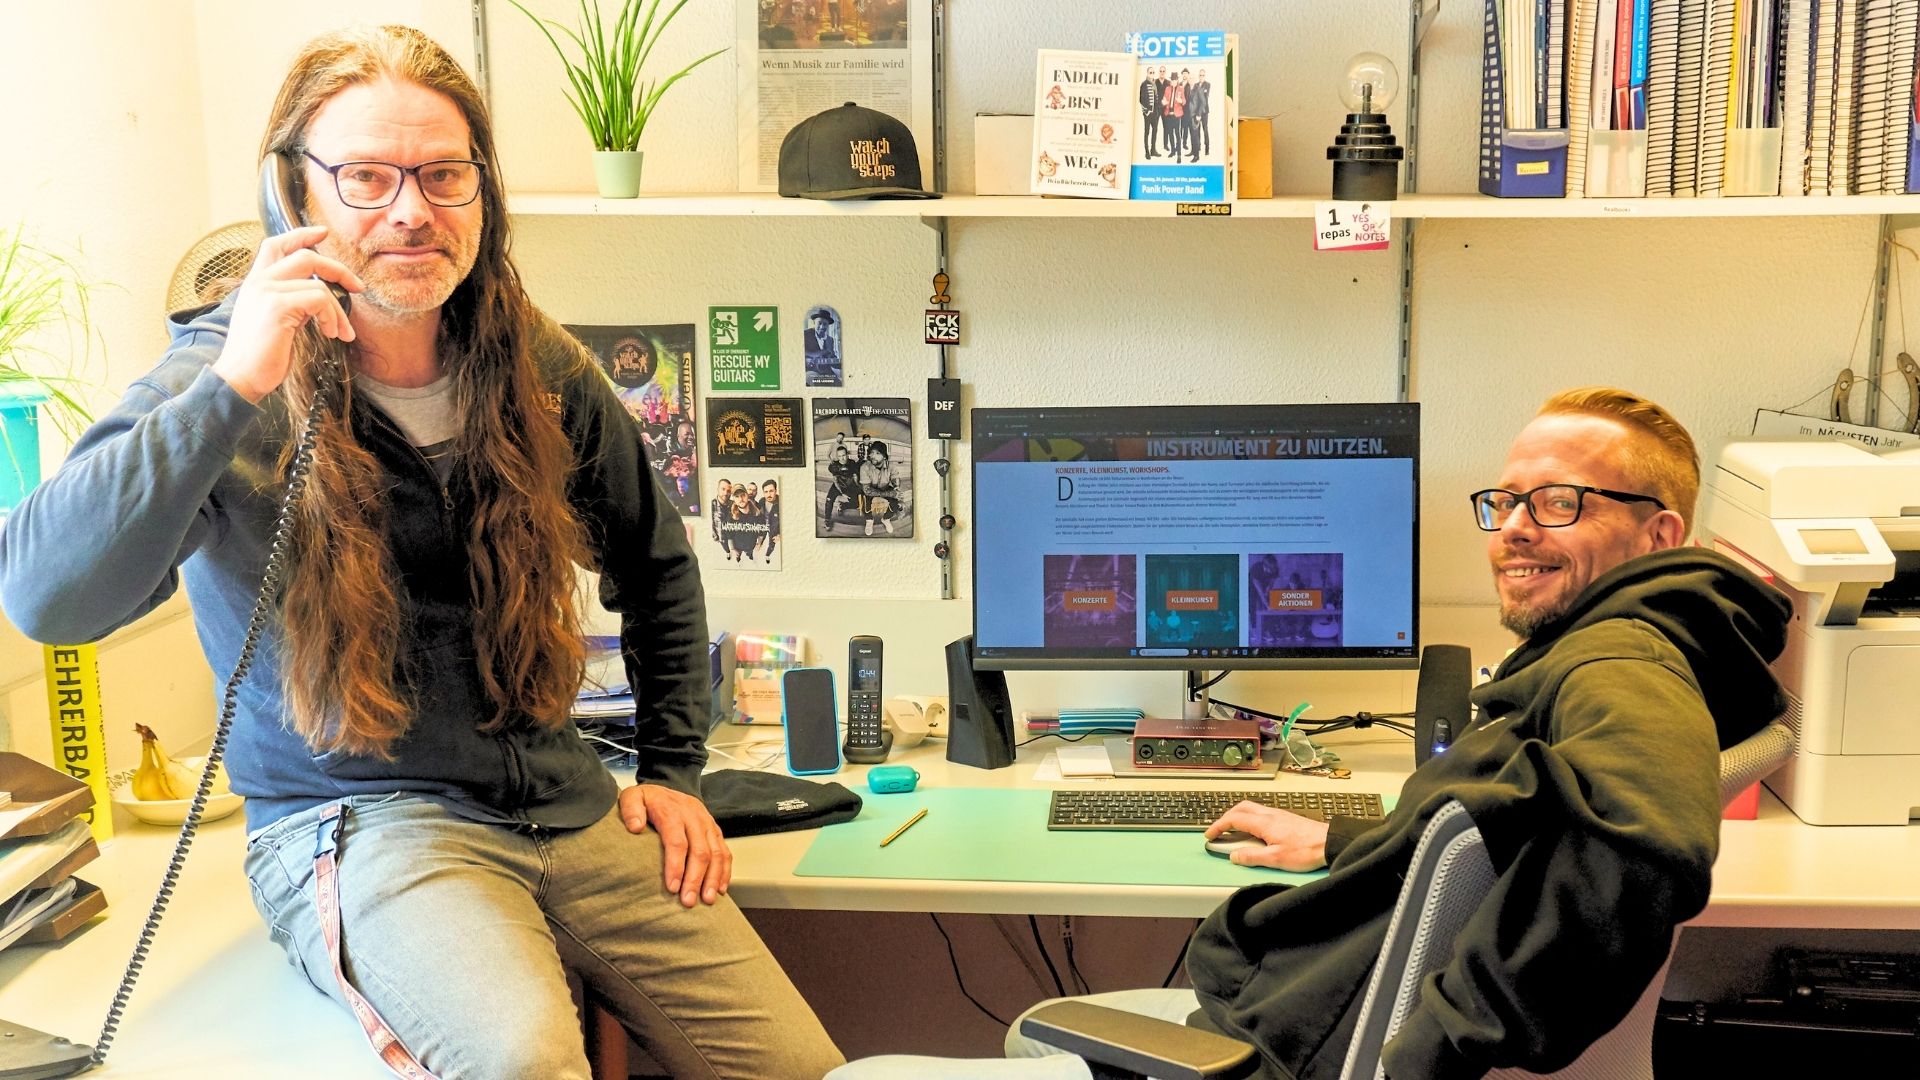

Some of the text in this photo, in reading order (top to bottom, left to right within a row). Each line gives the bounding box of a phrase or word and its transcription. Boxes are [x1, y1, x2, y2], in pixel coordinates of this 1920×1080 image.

[762, 60, 790, 69] Wenn
[792, 60, 822, 69] Musik
[843, 60, 880, 69] Familie
[882, 59, 904, 69] wird
[1053, 69, 1119, 86] ENDLICH
[1068, 96, 1102, 110] BIST
[1073, 122, 1094, 136] DU
[1064, 155, 1098, 169] WEG
[1142, 184, 1205, 194] Panik Power Band
[1178, 204, 1230, 215] Hartke
[1328, 208, 1340, 226] 1
[1352, 214, 1369, 222] YES
[1320, 229, 1350, 240] repas
[1355, 232, 1386, 241] NOTES
[926, 315, 959, 327] FCK
[926, 327, 959, 339] NZS
[713, 355, 770, 368] RESCUE MY
[713, 369, 756, 382] GUITARS
[934, 401, 955, 411] DEF
[1147, 438, 1388, 457] INSTRUMENT ZU NUTZEN.
[1880, 437, 1903, 448] Jahr
[1058, 477, 1074, 501] D
